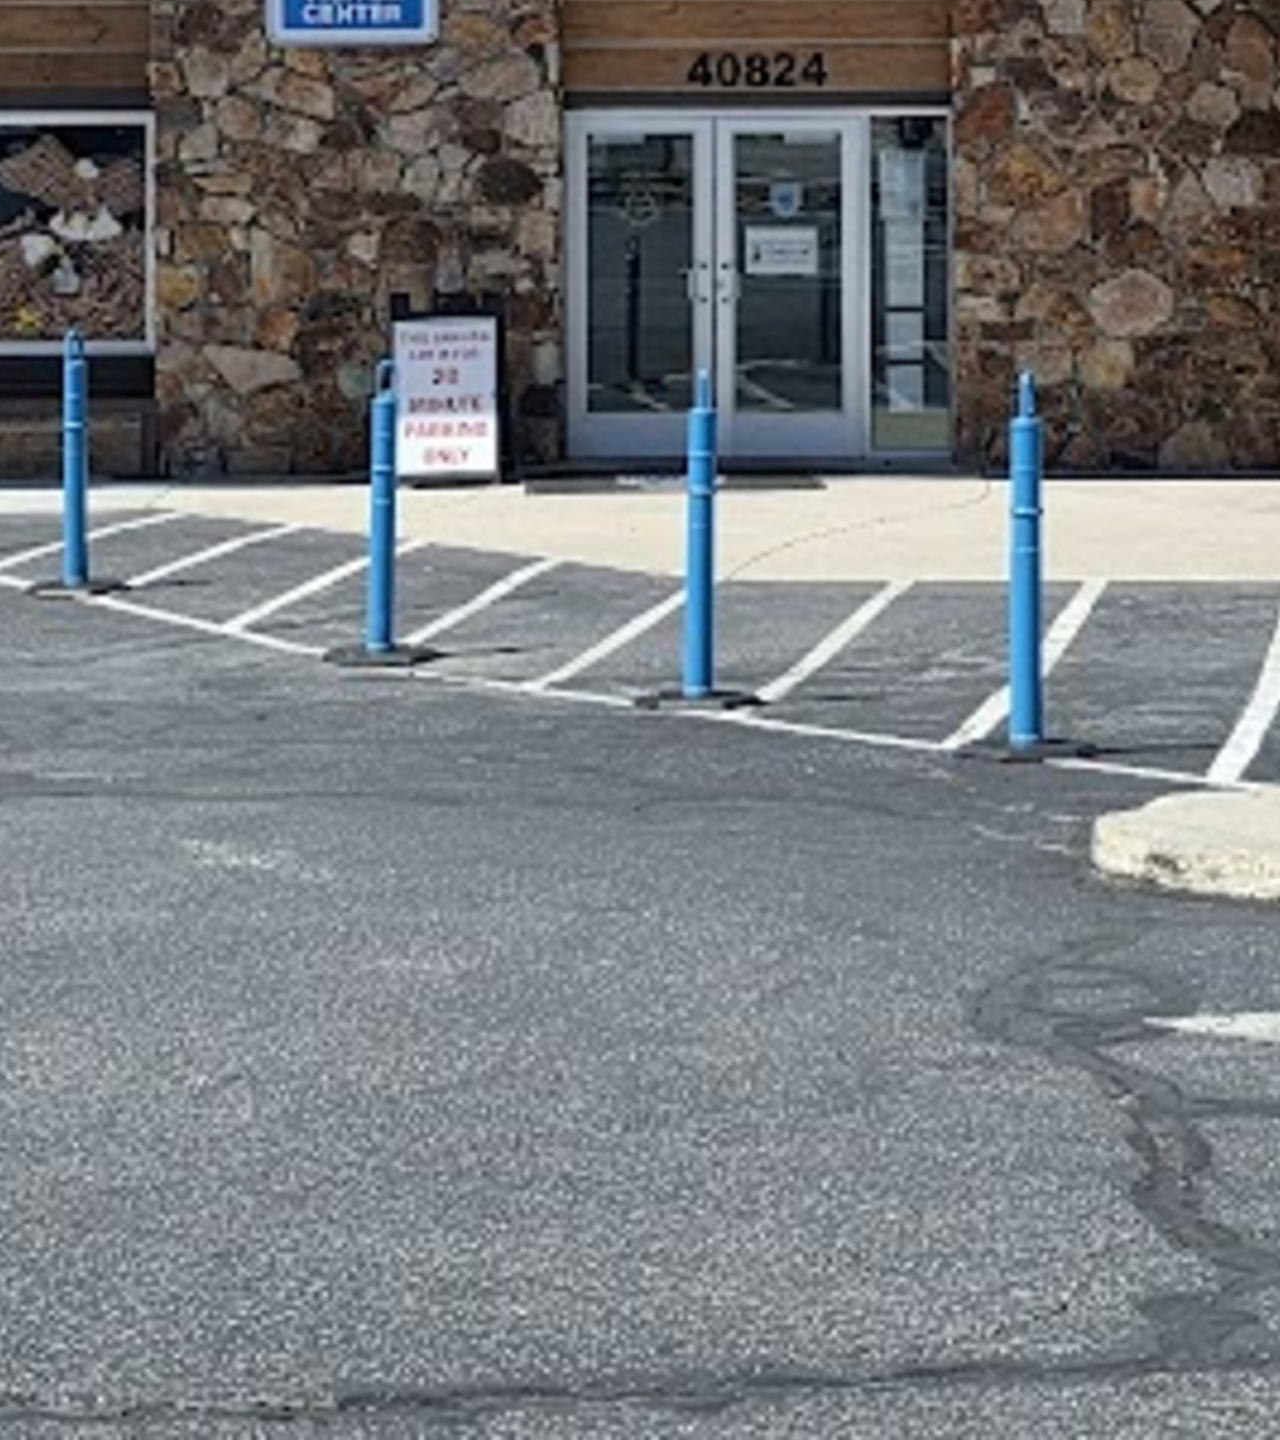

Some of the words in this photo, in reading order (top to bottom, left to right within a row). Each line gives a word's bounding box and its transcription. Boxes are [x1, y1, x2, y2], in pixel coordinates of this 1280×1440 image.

[302, 3, 401, 24] CENTER
[687, 52, 828, 87] 40824
[404, 421, 488, 438] PARKING
[423, 446, 471, 465] ONLY
